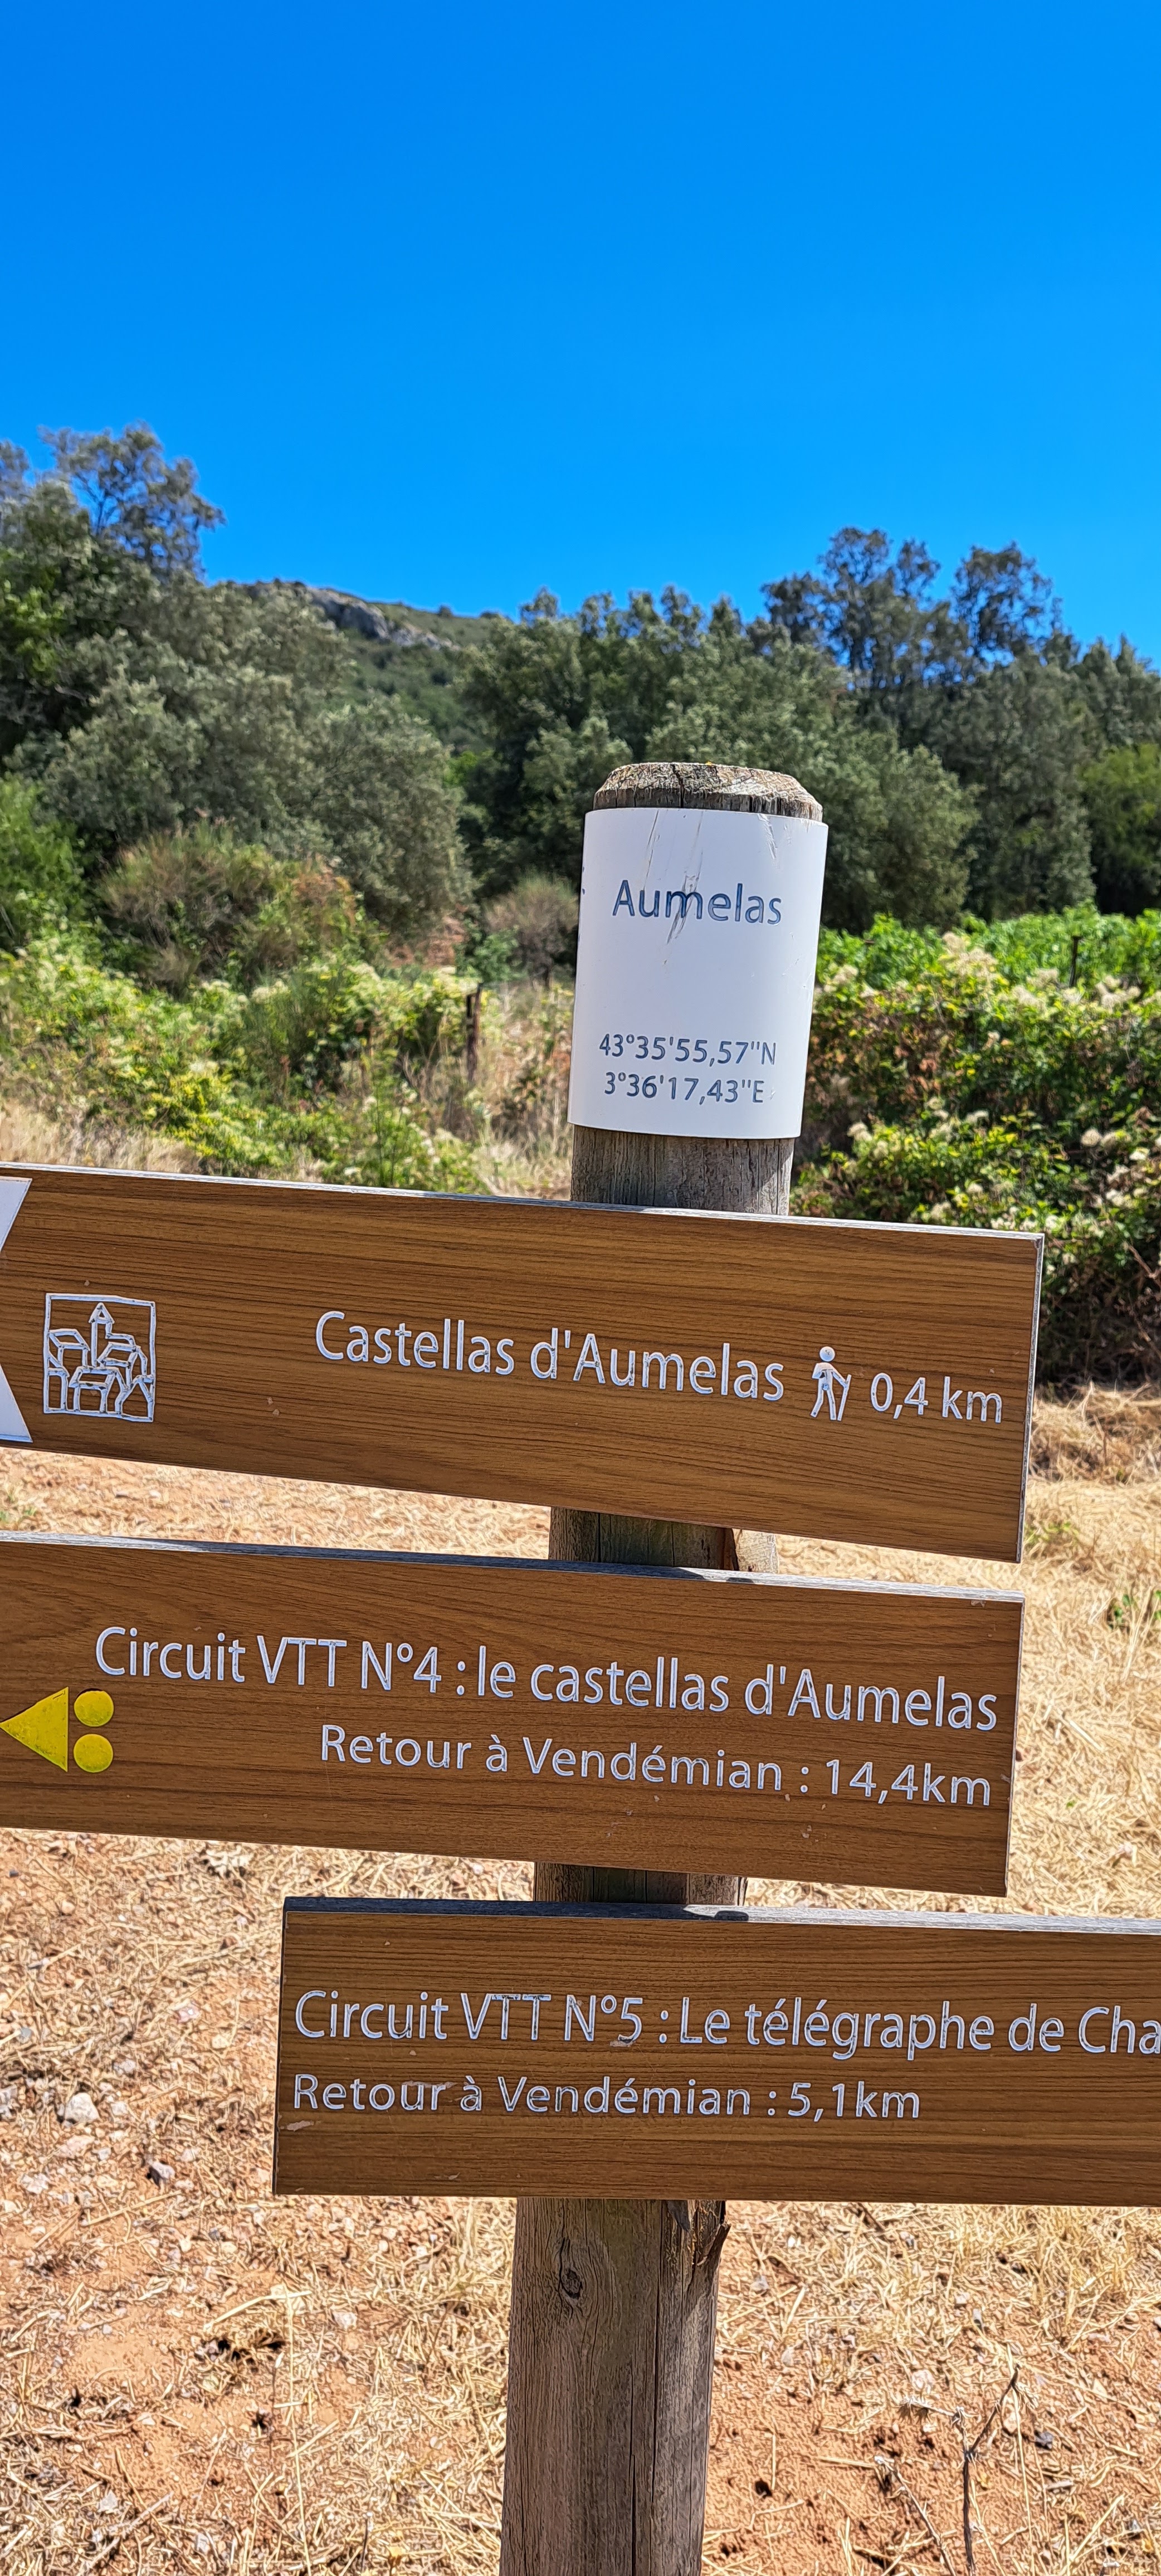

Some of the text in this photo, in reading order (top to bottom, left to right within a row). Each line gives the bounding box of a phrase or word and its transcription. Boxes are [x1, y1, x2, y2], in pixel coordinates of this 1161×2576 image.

[612, 879, 782, 926] Aumelas
[316, 1311, 1002, 1423] Castellas d'Aumelas 0,4 km
[96, 1626, 246, 1682] Circuit
[257, 1635, 347, 1687] VTT
[361, 1641, 442, 1693] N°4
[478, 1645, 516, 1698] le
[530, 1656, 729, 1712] castellas
[745, 1663, 997, 1731] d'Aumelas
[321, 1724, 471, 1769] Retour
[486, 1734, 508, 1772] à
[523, 1736, 782, 1790] Vendémian
[826, 1759, 990, 1806] 14,4km
[295, 1990, 448, 2040] Circuit
[460, 1993, 552, 2040] VTT
[564, 1994, 643, 2041] N°5
[680, 1997, 730, 2044] Le
[744, 1997, 994, 2061] télégraphe
[1008, 2003, 1064, 2052] de
[1079, 2005, 1161, 2054] Cha
[294, 2074, 446, 2110] Retour
[460, 2075, 482, 2111] à
[497, 2076, 750, 2115] Vendémian
[788, 2081, 919, 2122] 5,1km
